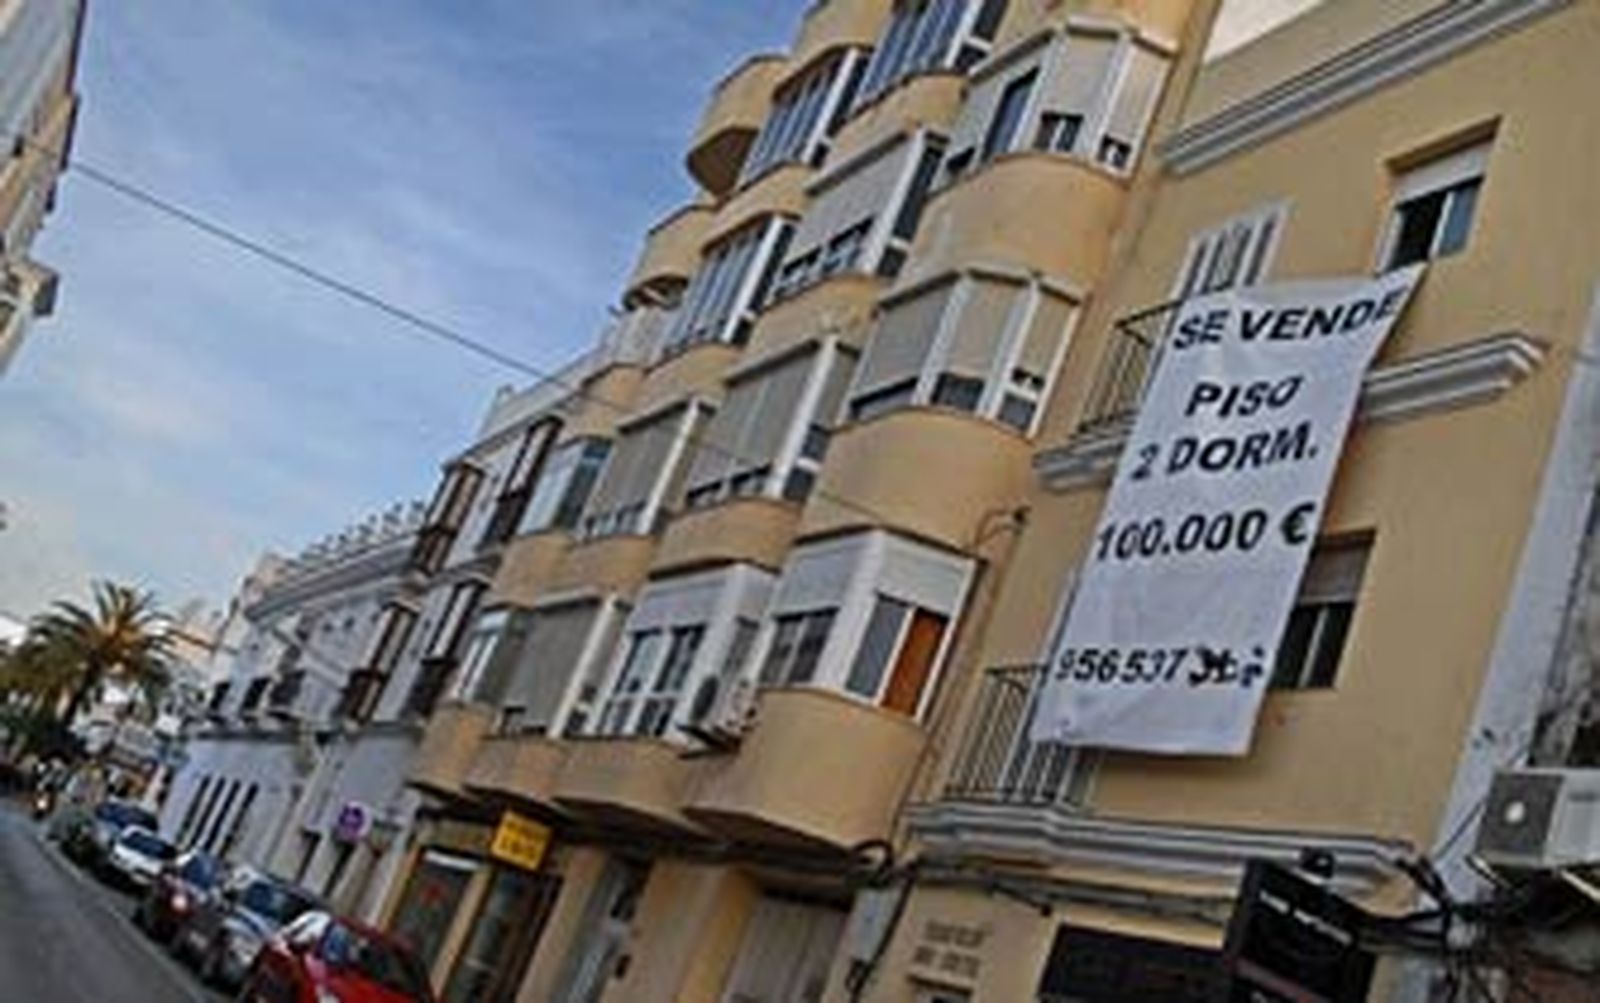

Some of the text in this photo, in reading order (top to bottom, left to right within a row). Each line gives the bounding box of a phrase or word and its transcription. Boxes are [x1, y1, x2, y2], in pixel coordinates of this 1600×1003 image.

[1173, 287, 1407, 348] SE VENDE
[1185, 376, 1303, 416] PISO
[1131, 423, 1319, 480] 2 DORM.
[1097, 503, 1315, 560] 100.000 €
